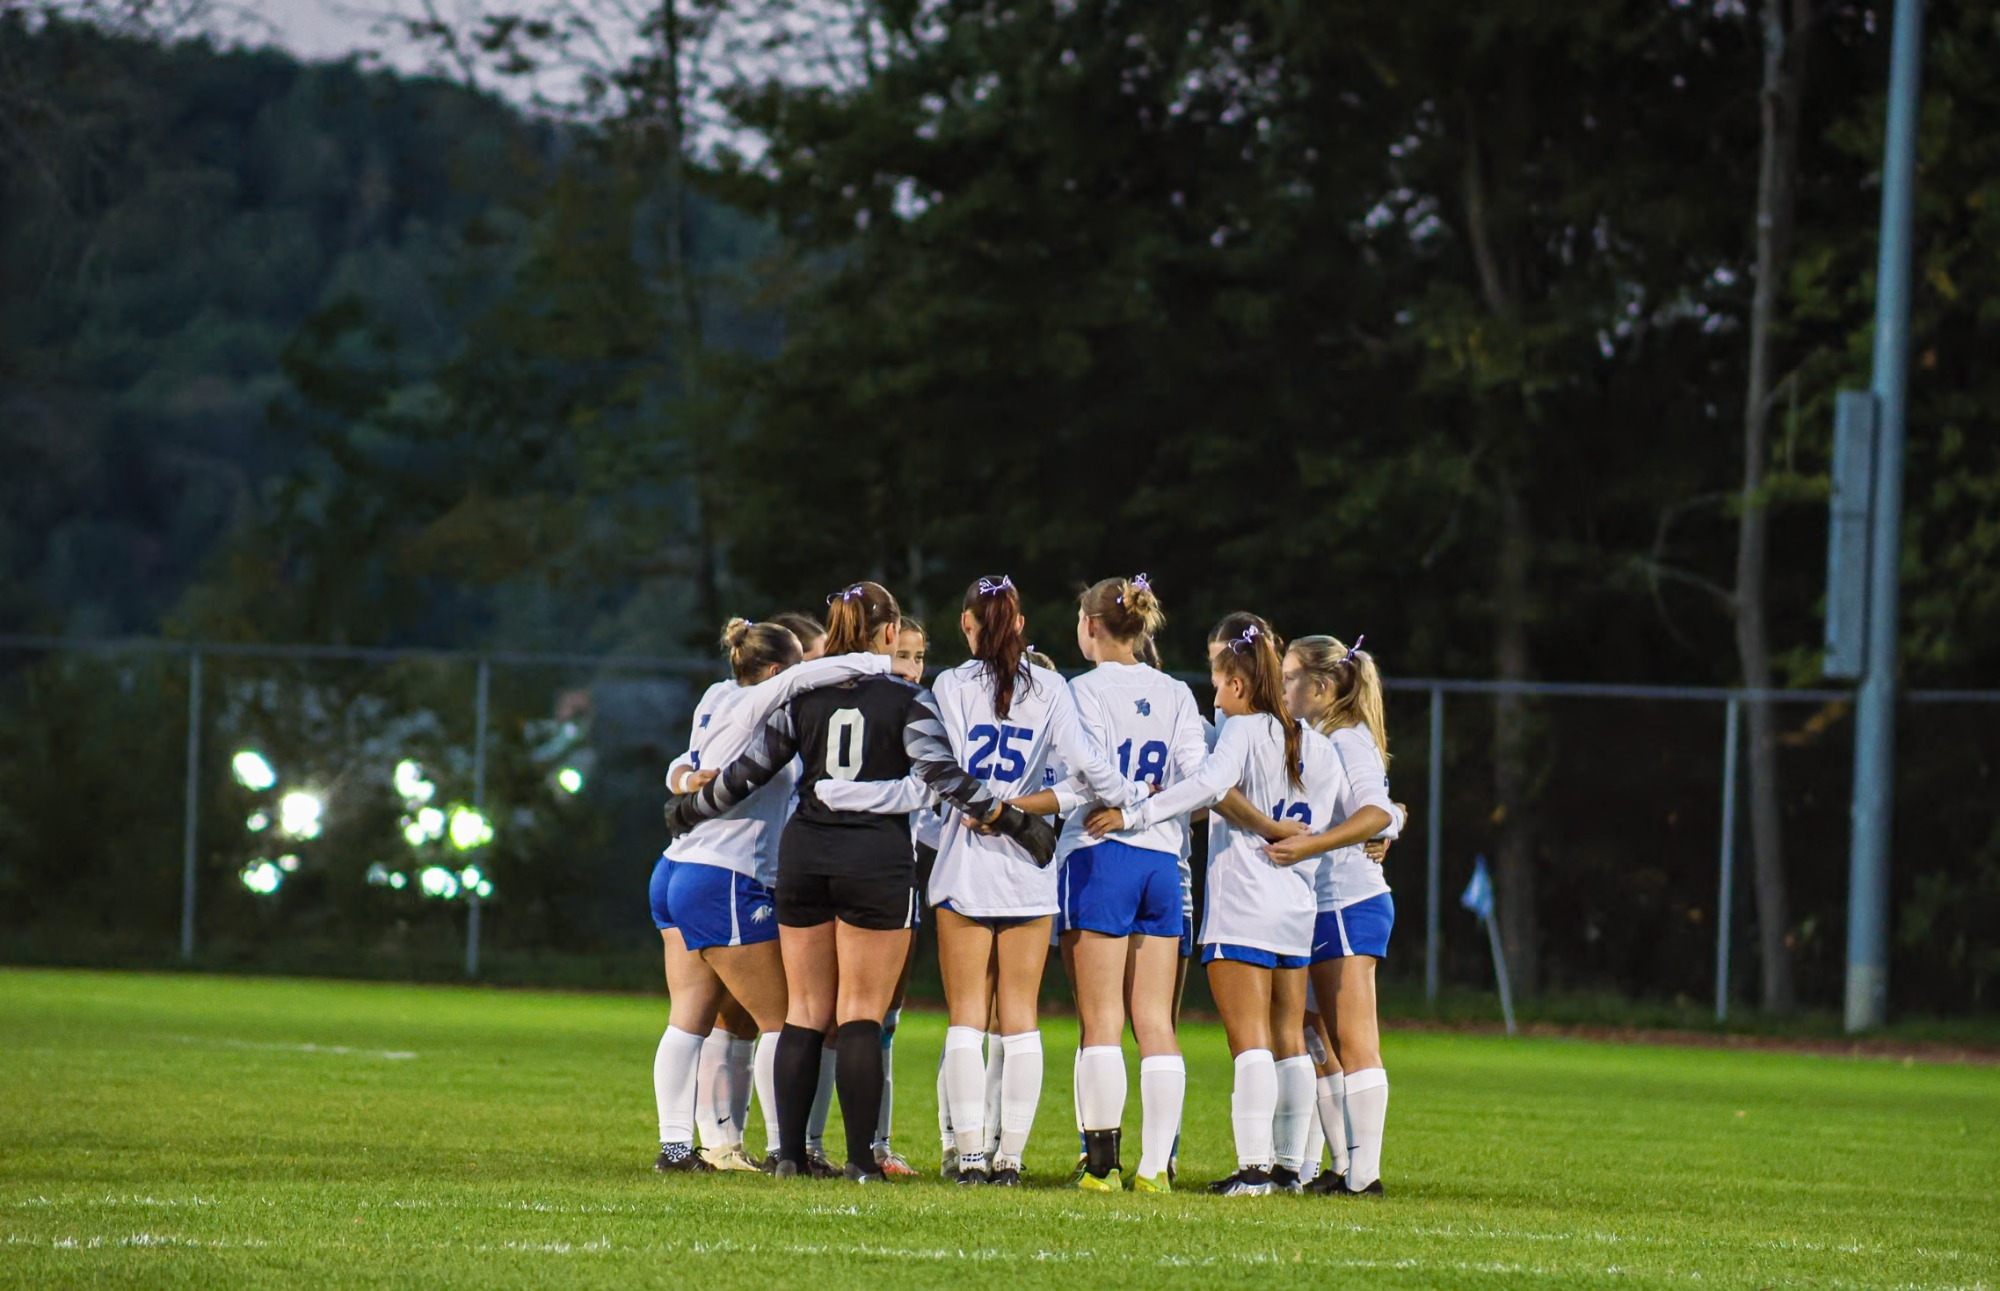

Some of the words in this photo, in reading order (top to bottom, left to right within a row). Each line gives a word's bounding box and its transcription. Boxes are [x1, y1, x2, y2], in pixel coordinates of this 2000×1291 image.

[826, 707, 865, 780] 0
[967, 724, 1034, 783] 25
[1117, 738, 1168, 785] 18
